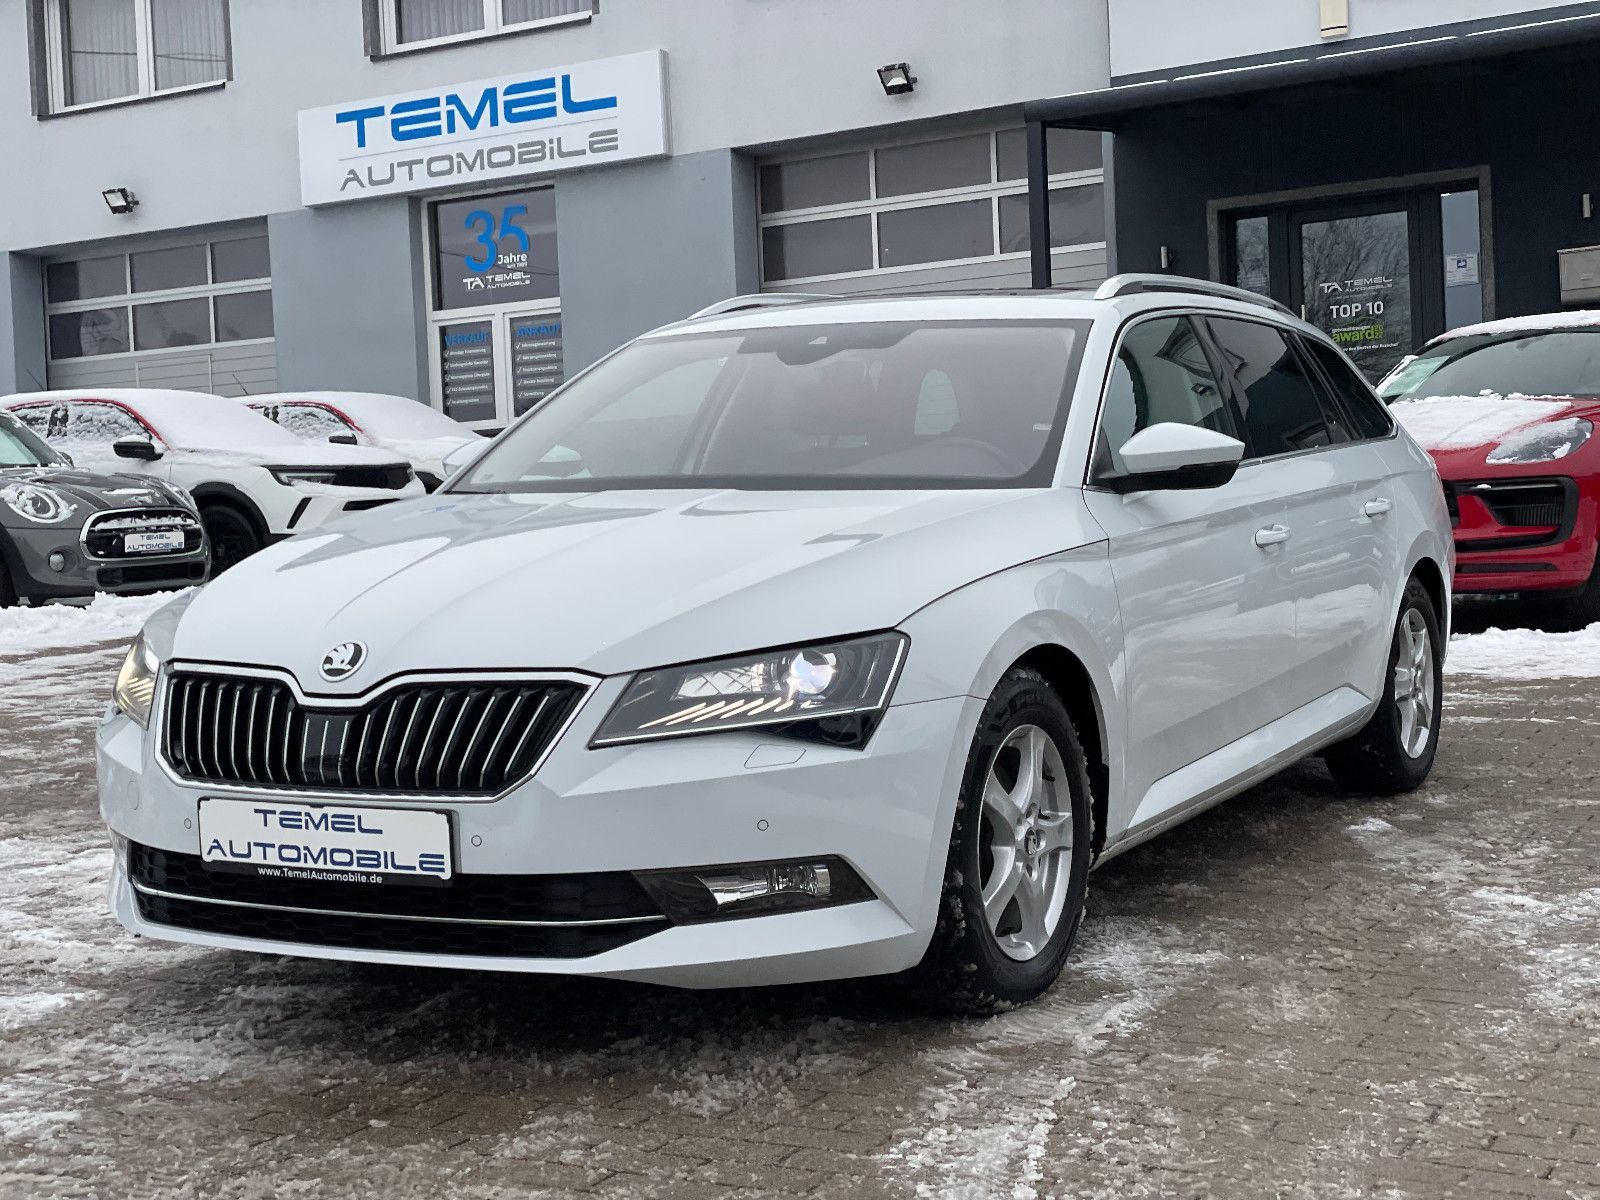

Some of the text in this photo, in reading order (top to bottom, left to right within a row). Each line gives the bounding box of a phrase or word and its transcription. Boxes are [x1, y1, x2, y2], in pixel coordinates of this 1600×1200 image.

[336, 74, 617, 148] TEMEL
[464, 205, 529, 273] 35
[498, 253, 527, 264] Jahre
[462, 277, 485, 290] TA
[486, 272, 530, 282] TEMEL
[1344, 276, 1392, 286] TEMEL
[1320, 282, 1342, 293] TA
[1330, 300, 1384, 318] TOP 10
[516, 322, 561, 337] ANKAUF
[1332, 326, 1374, 342] award
[445, 330, 488, 346] VERKAUF
[127, 542, 183, 550] AUTOMOBILE
[254, 808, 383, 834] TEMEL
[207, 838, 445, 873] AUTOMOBILE
[258, 867, 382, 884] www.TemelAutomobile.de
